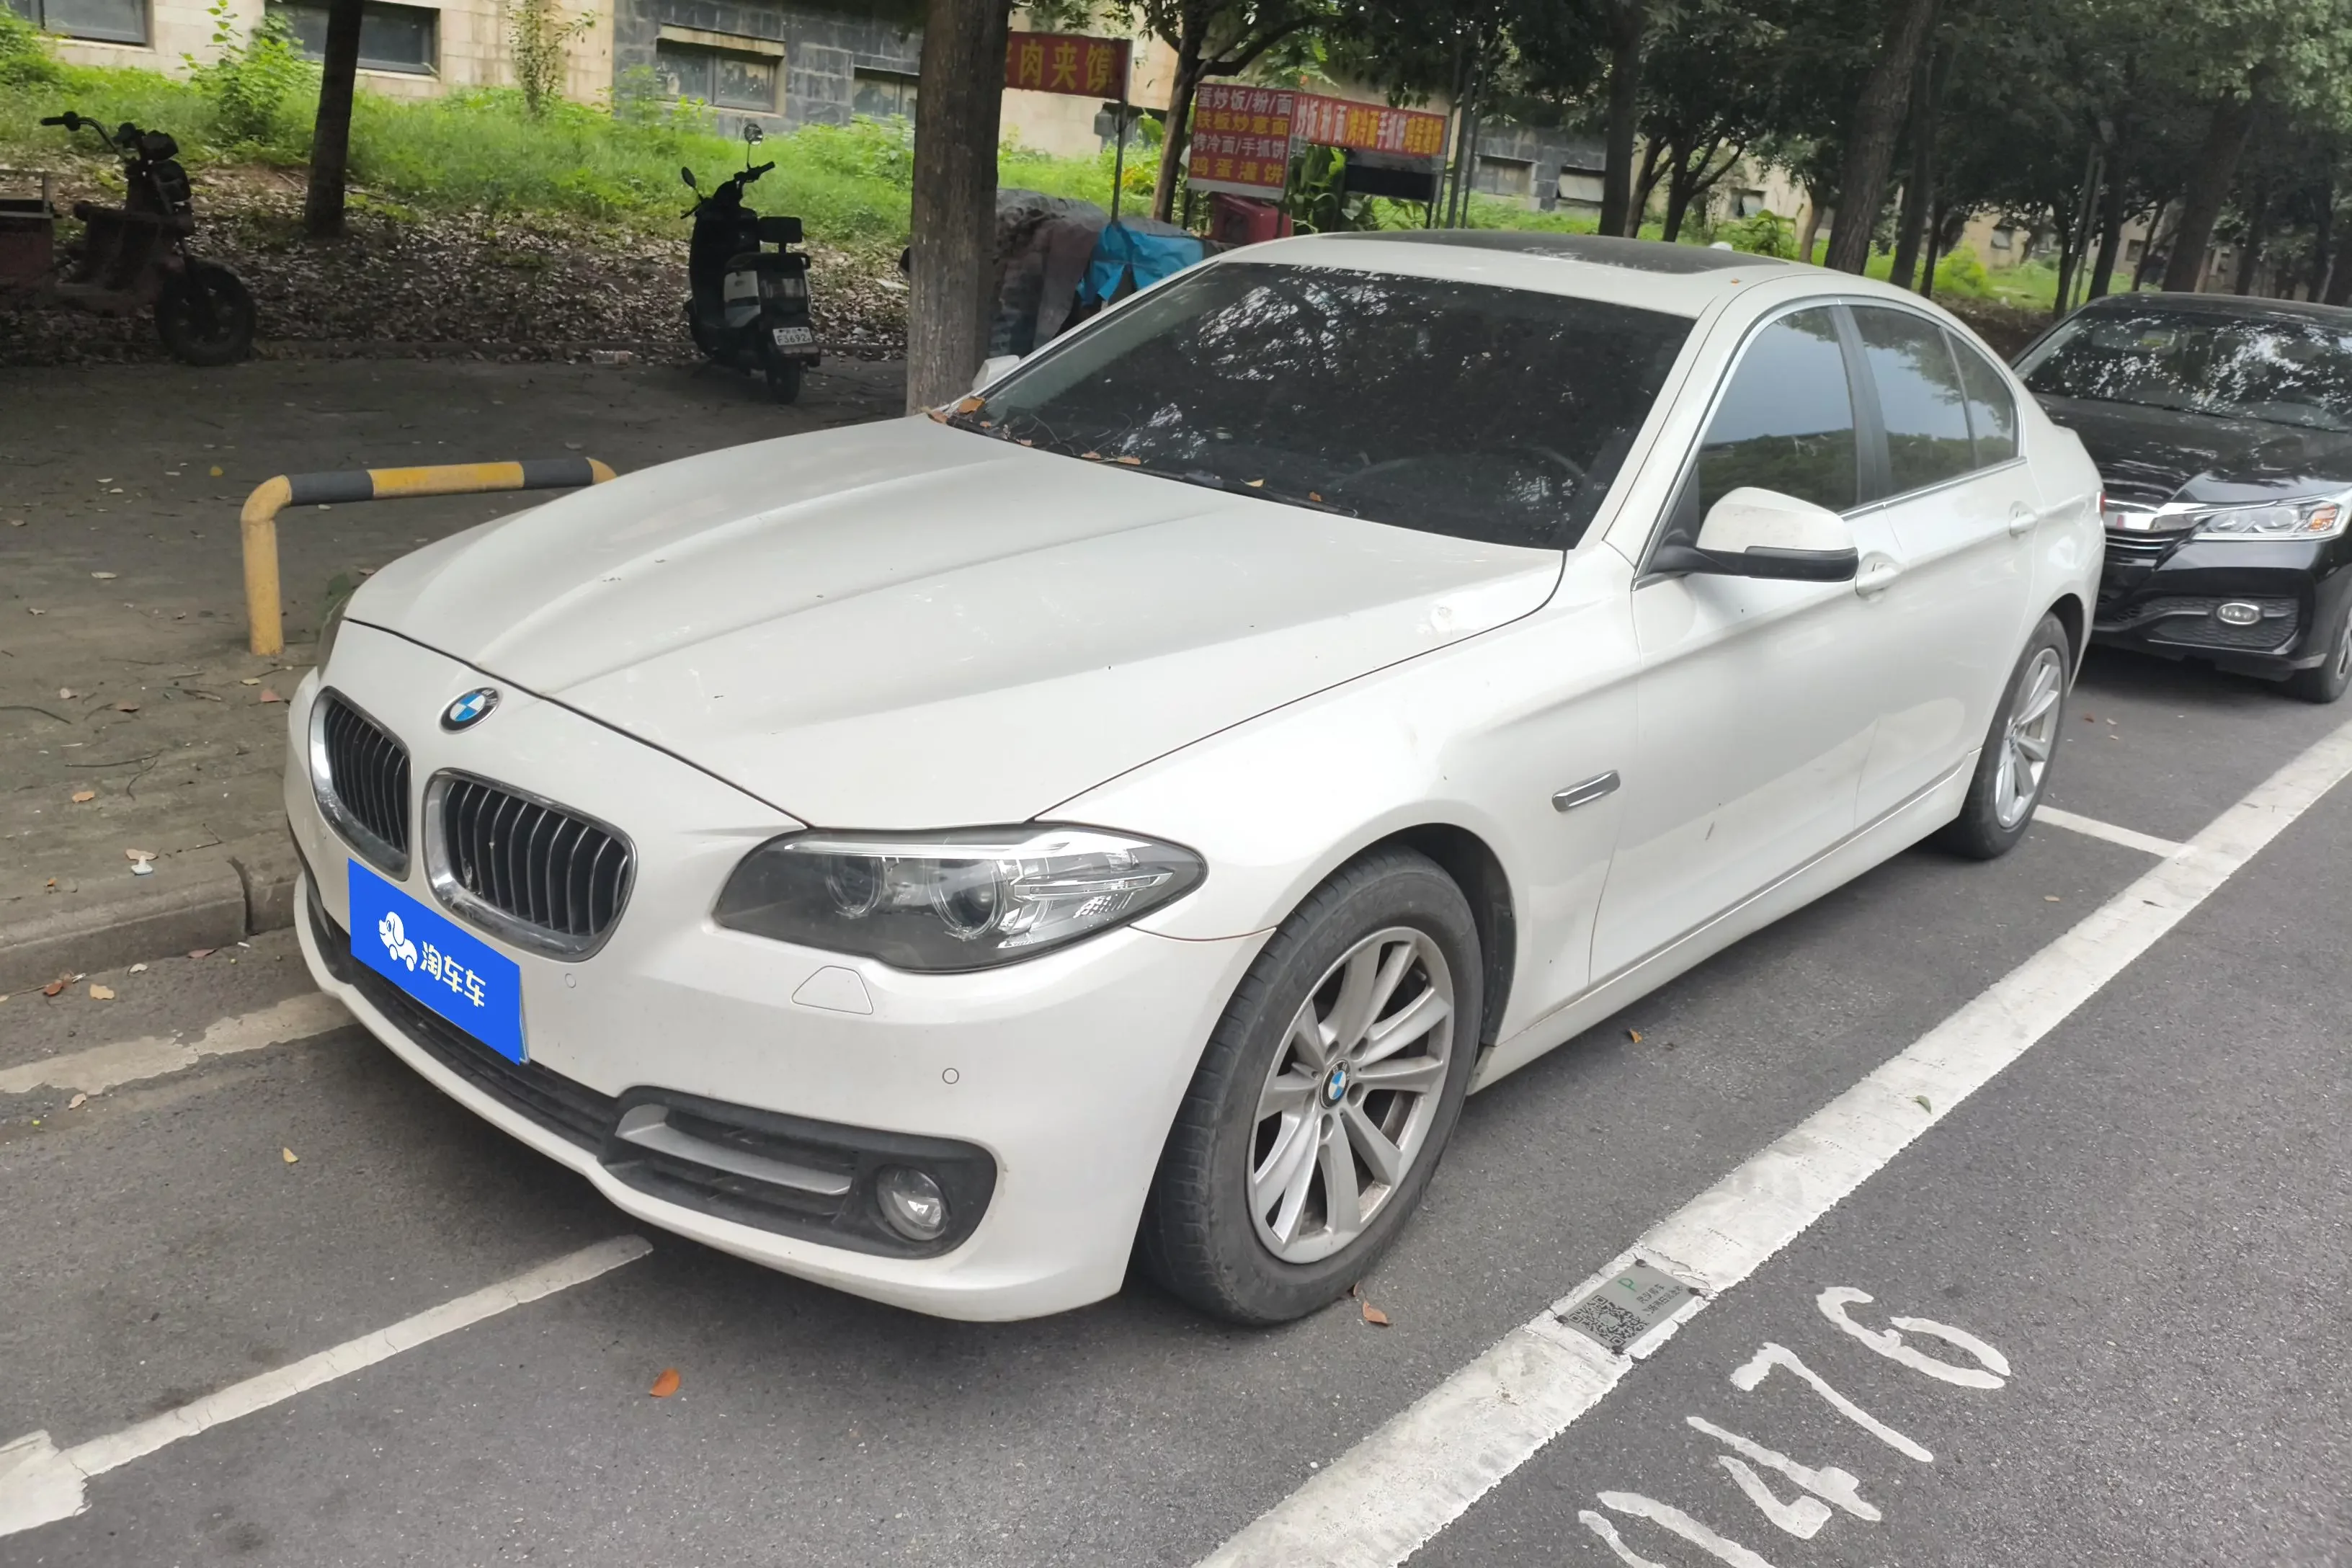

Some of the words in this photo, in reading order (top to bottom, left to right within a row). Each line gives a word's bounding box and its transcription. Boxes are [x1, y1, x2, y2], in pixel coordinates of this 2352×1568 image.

[1004, 38, 1116, 92] 肉夹馍
[1197, 86, 1293, 116] 蛋炒饭/粉/面
[1195, 110, 1289, 136] 铁板炒意面
[1193, 131, 1286, 160] 烤冷面/手抓饼
[1190, 156, 1284, 184] 鸡蛋灌饼
